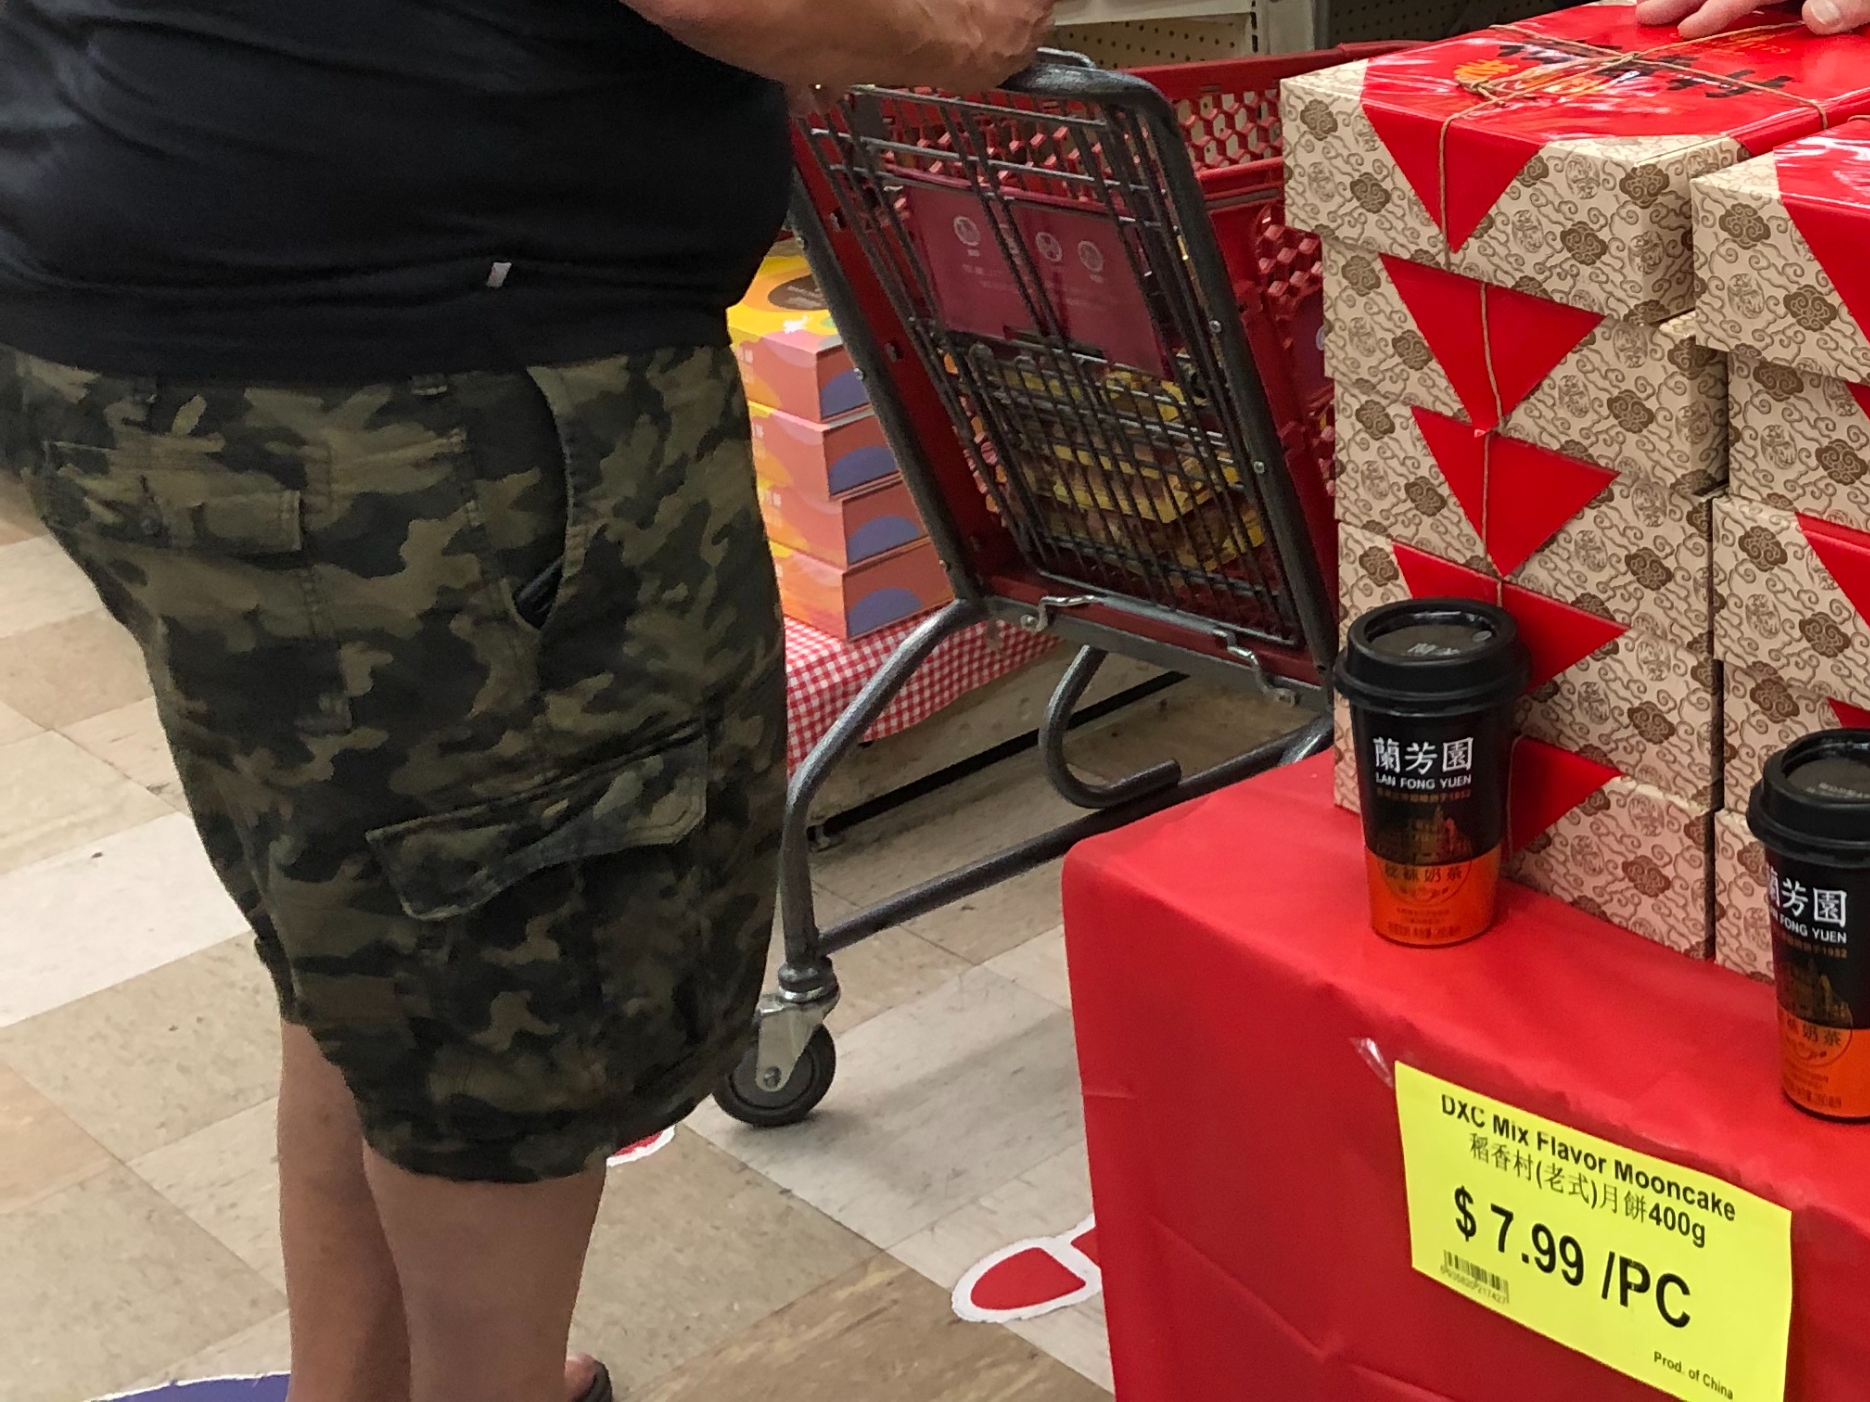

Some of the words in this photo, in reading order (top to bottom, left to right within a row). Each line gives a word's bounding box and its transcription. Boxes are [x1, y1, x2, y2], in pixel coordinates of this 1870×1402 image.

[1372, 736, 1474, 776] 蘭芳園
[1375, 772, 1396, 787] LAN
[1400, 775, 1436, 791] FONG
[1440, 774, 1472, 789] YUEN
[1780, 914, 1808, 937] FONG
[1812, 927, 1847, 944] YUEN
[1441, 1094, 1486, 1129] DXC
[1492, 1114, 1529, 1146] Mix
[1536, 1131, 1607, 1174] Flavor
[1614, 1160, 1736, 1221] Mooncake
[1454, 1186, 1477, 1241] $
[1490, 1202, 1585, 1287] 7.99
[1601, 1251, 1692, 1328] /PC
[1654, 1350, 1685, 1376] Prod.
[1688, 1366, 1700, 1381] of
[1702, 1371, 1734, 1400] China
